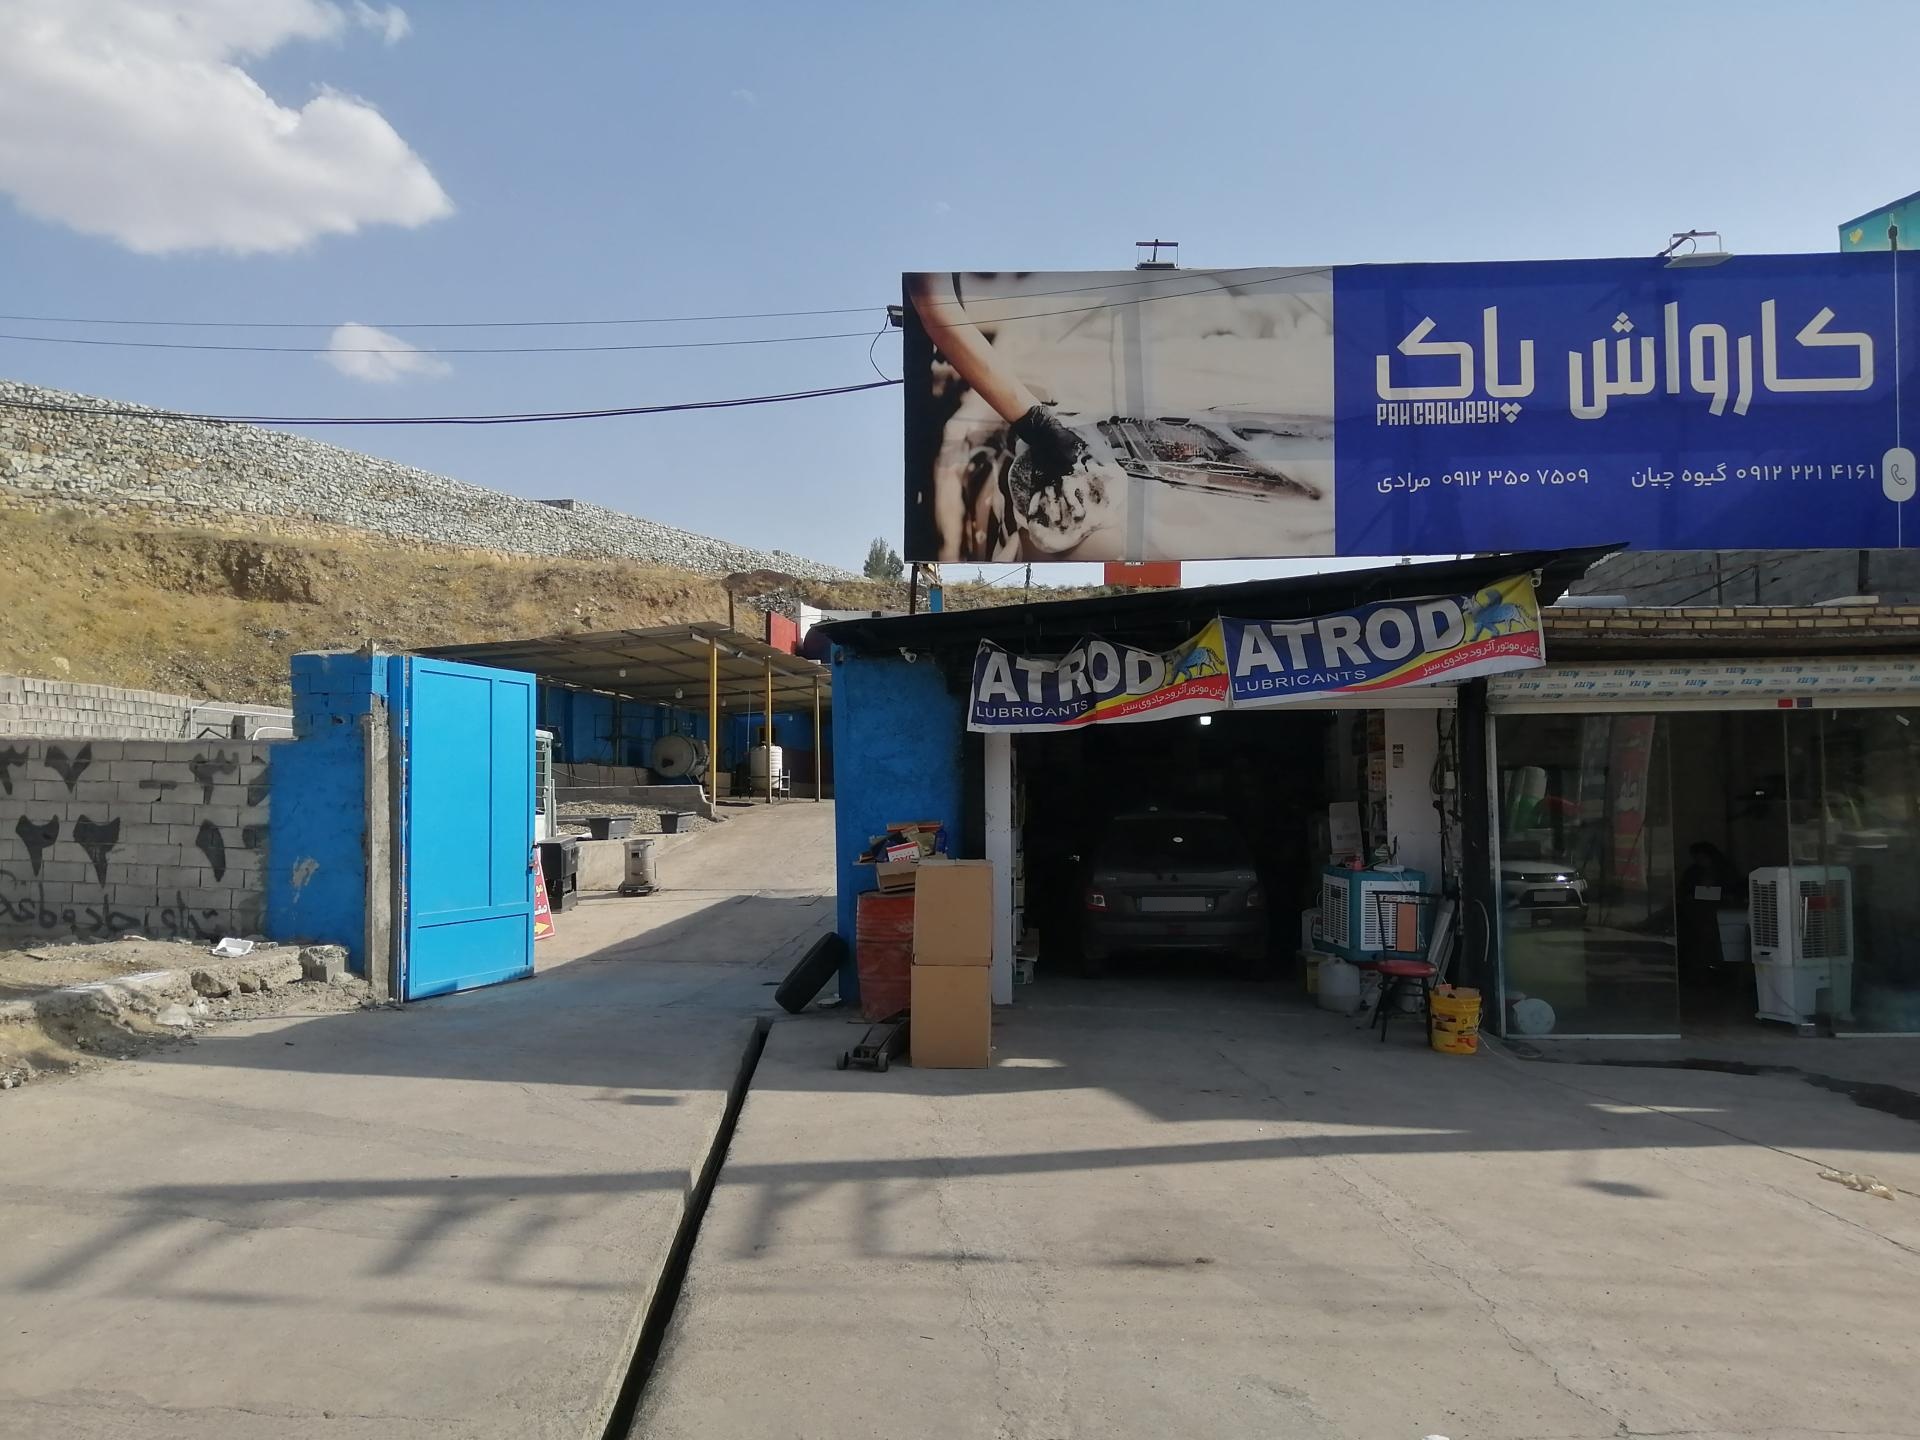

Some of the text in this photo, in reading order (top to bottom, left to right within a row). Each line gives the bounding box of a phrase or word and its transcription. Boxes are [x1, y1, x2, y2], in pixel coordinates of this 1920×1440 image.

[1376, 299, 1874, 423] کارواش پاک
[1376, 472, 1432, 494] مرادی
[1234, 599, 1467, 678] ATROD
[977, 640, 1166, 703] ATROD
[1235, 669, 1367, 693] LUBRICANTS
[976, 700, 1088, 719] LUBRICANTS
